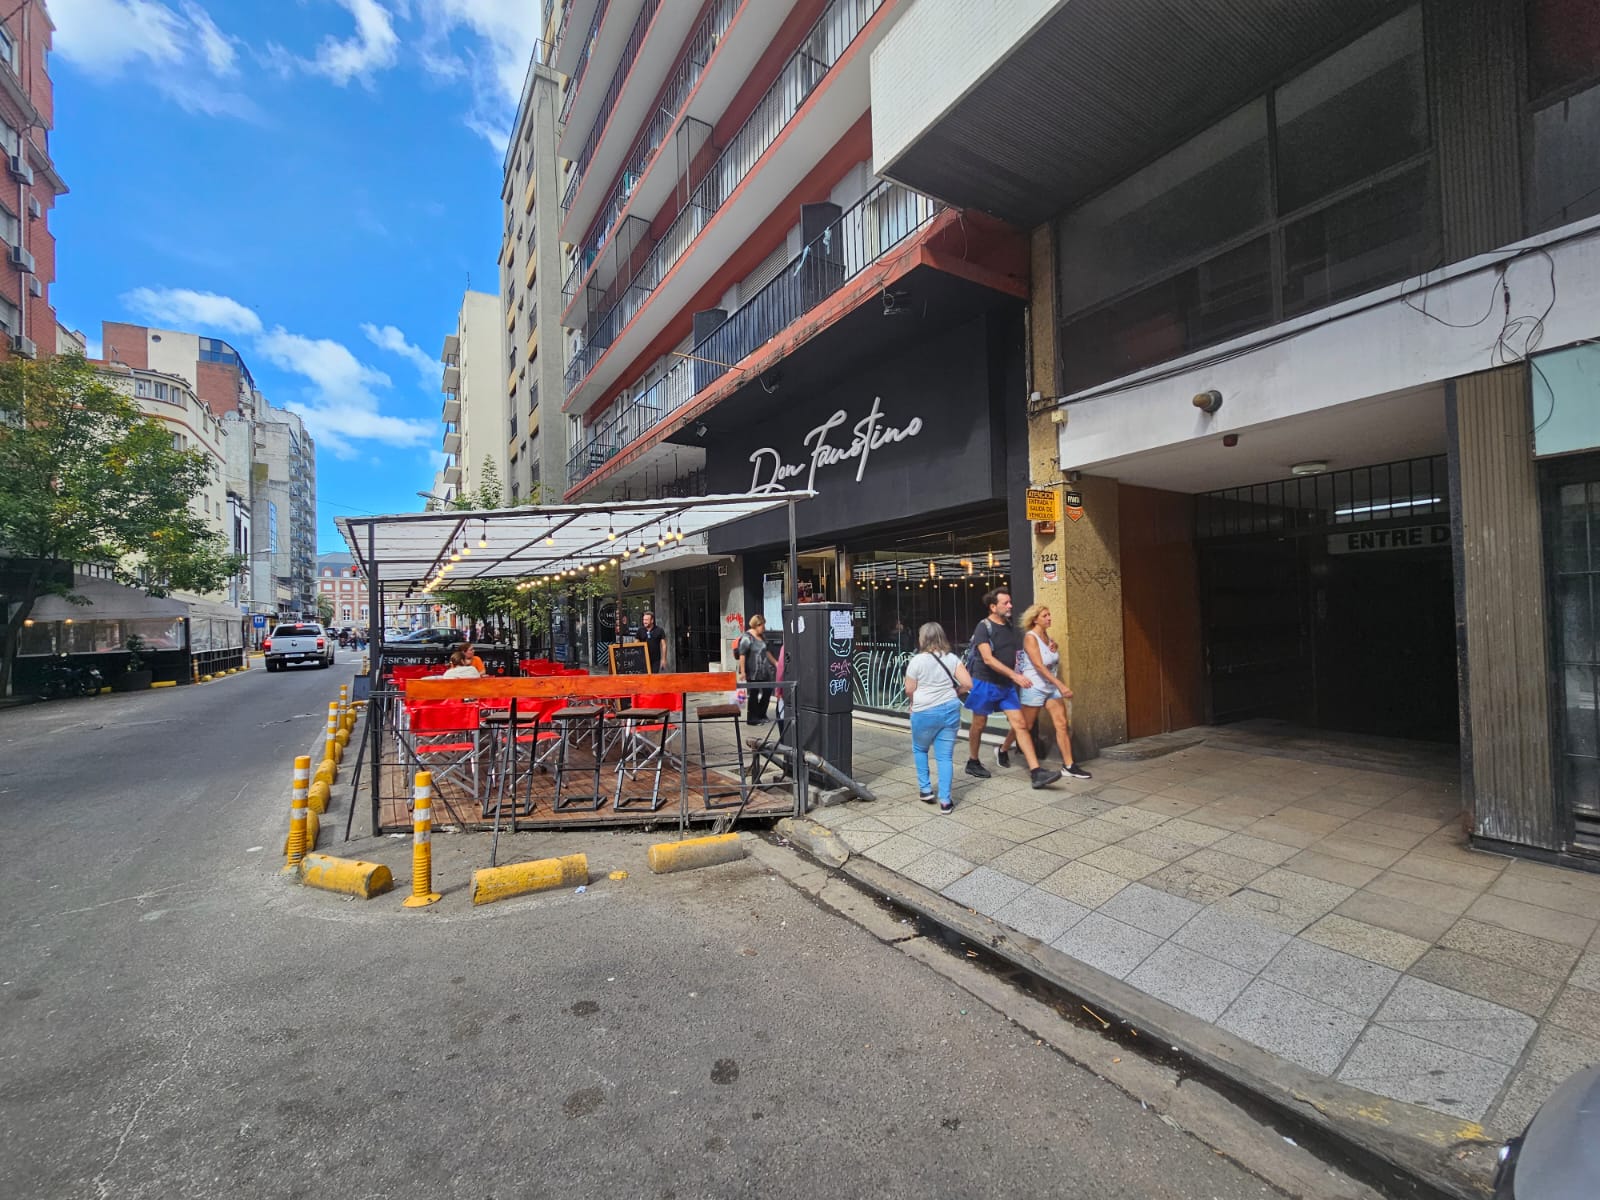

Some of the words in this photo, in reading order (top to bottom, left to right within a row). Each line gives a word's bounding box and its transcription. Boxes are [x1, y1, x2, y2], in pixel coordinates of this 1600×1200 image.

[748, 448, 806, 494] Don
[803, 396, 924, 498] Faustino
[1347, 527, 1422, 550] ENTRE
